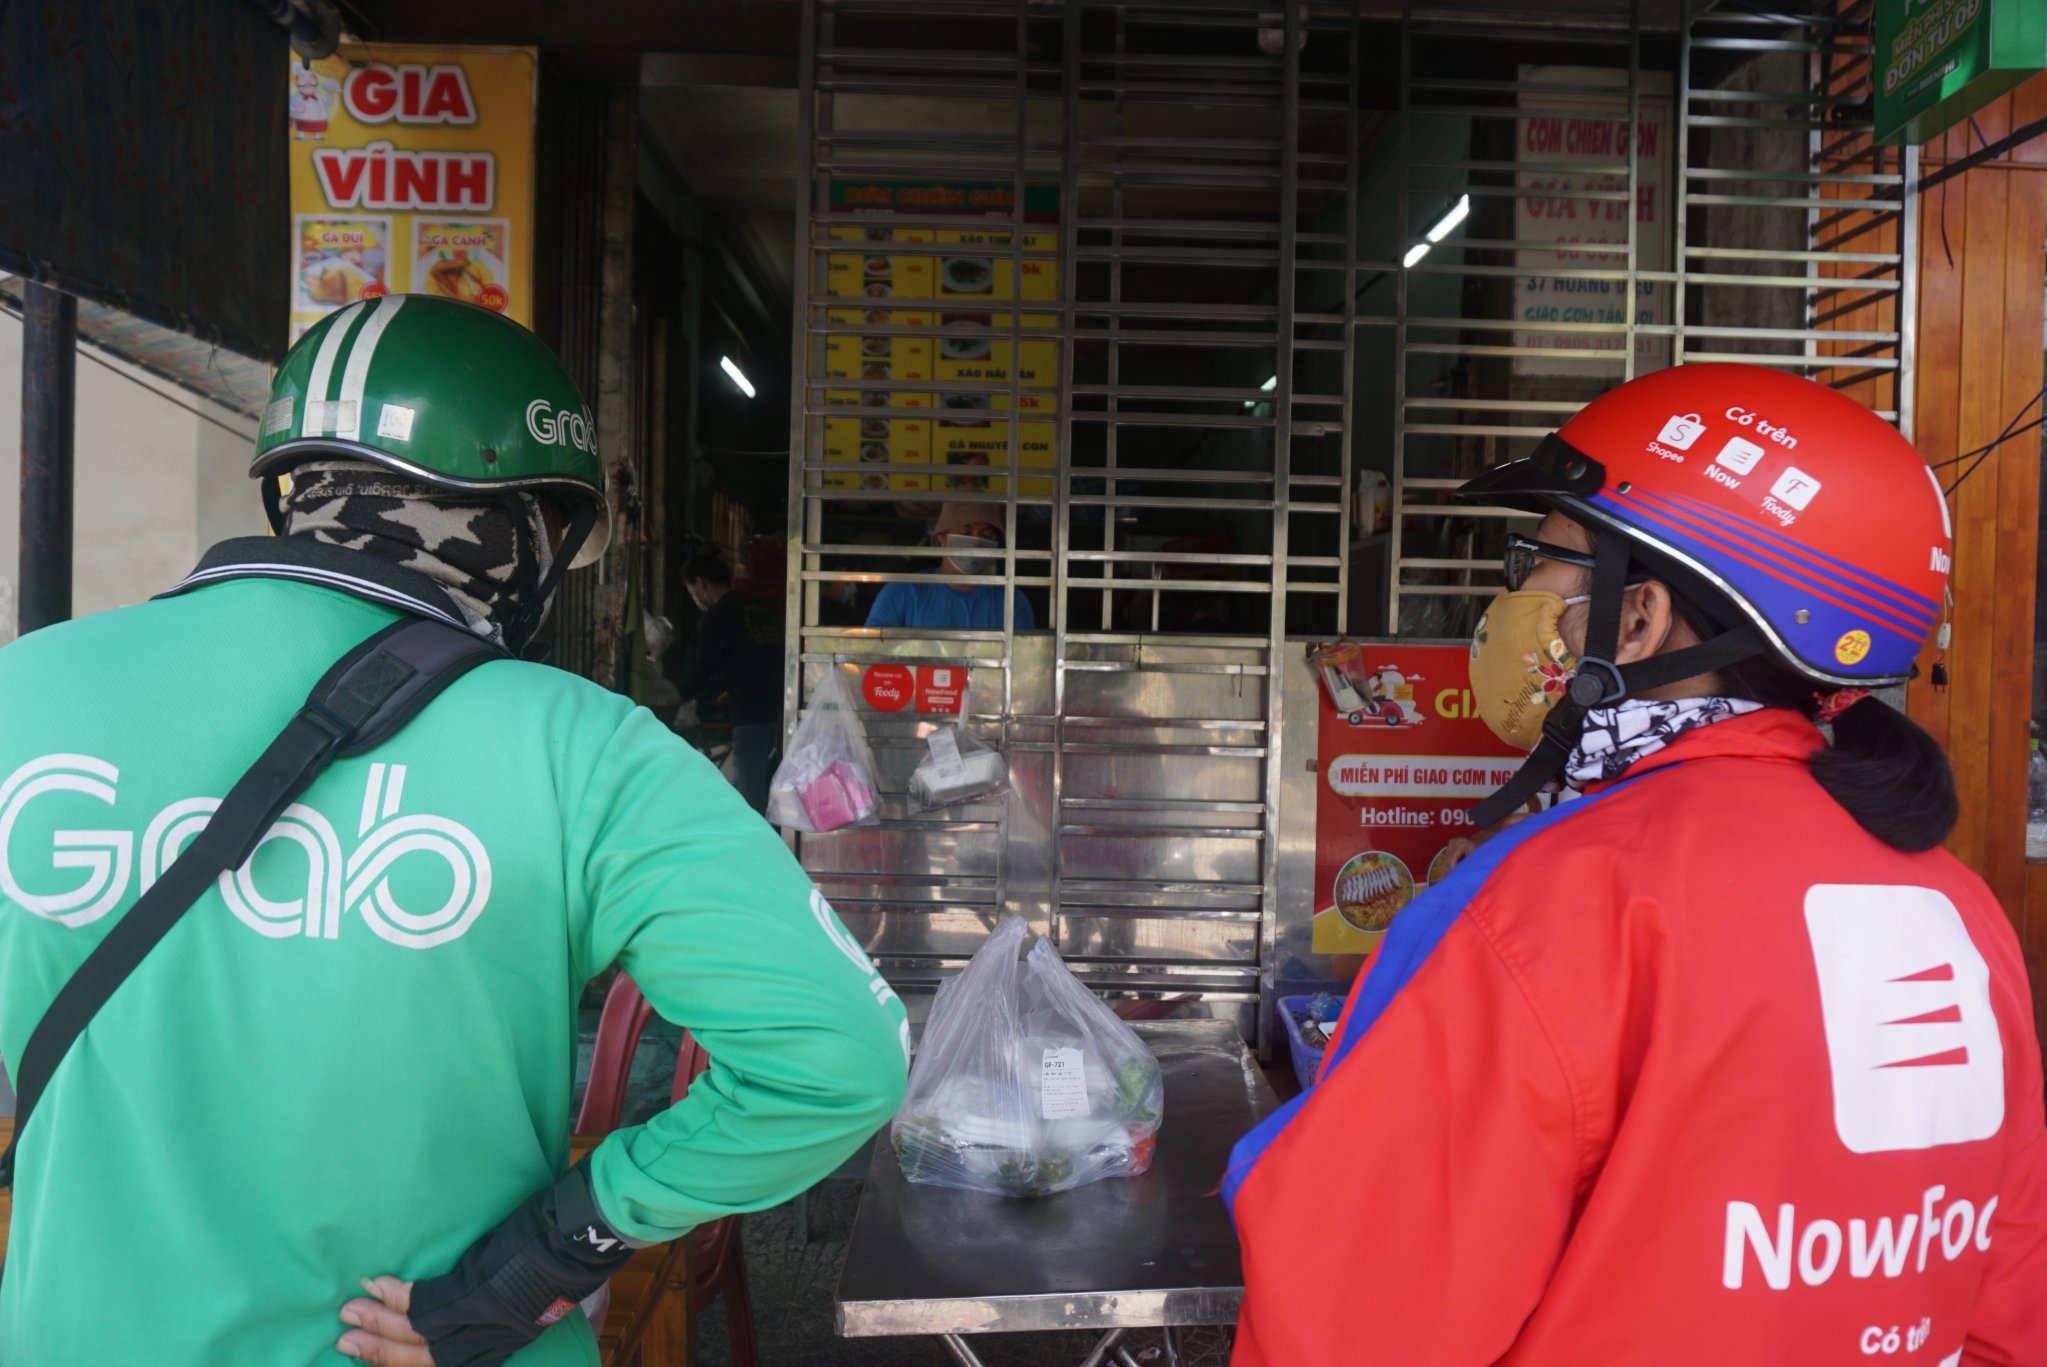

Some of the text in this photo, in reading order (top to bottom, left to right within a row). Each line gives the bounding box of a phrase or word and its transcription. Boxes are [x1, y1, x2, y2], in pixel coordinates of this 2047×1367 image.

[346, 66, 474, 123] GIA
[316, 143, 493, 209] VĨNH
[526, 398, 598, 457] Grab
[1725, 406, 1799, 450] Có trên
[1646, 441, 1686, 464] Shopee
[1703, 464, 1742, 490] Now
[1762, 495, 1797, 527] Foody
[873, 671, 894, 679] Review
[925, 687, 958, 696] NowFood
[1340, 762, 1379, 784] MIỄN
[1384, 766, 1409, 785] PHÍ
[1413, 768, 1448, 785] GIAO
[1452, 767, 1486, 786] CƠM
[1361, 807, 1435, 826] Hotline:
[0, 753, 492, 949] Grab
[1860, 1325, 1901, 1355] Có
